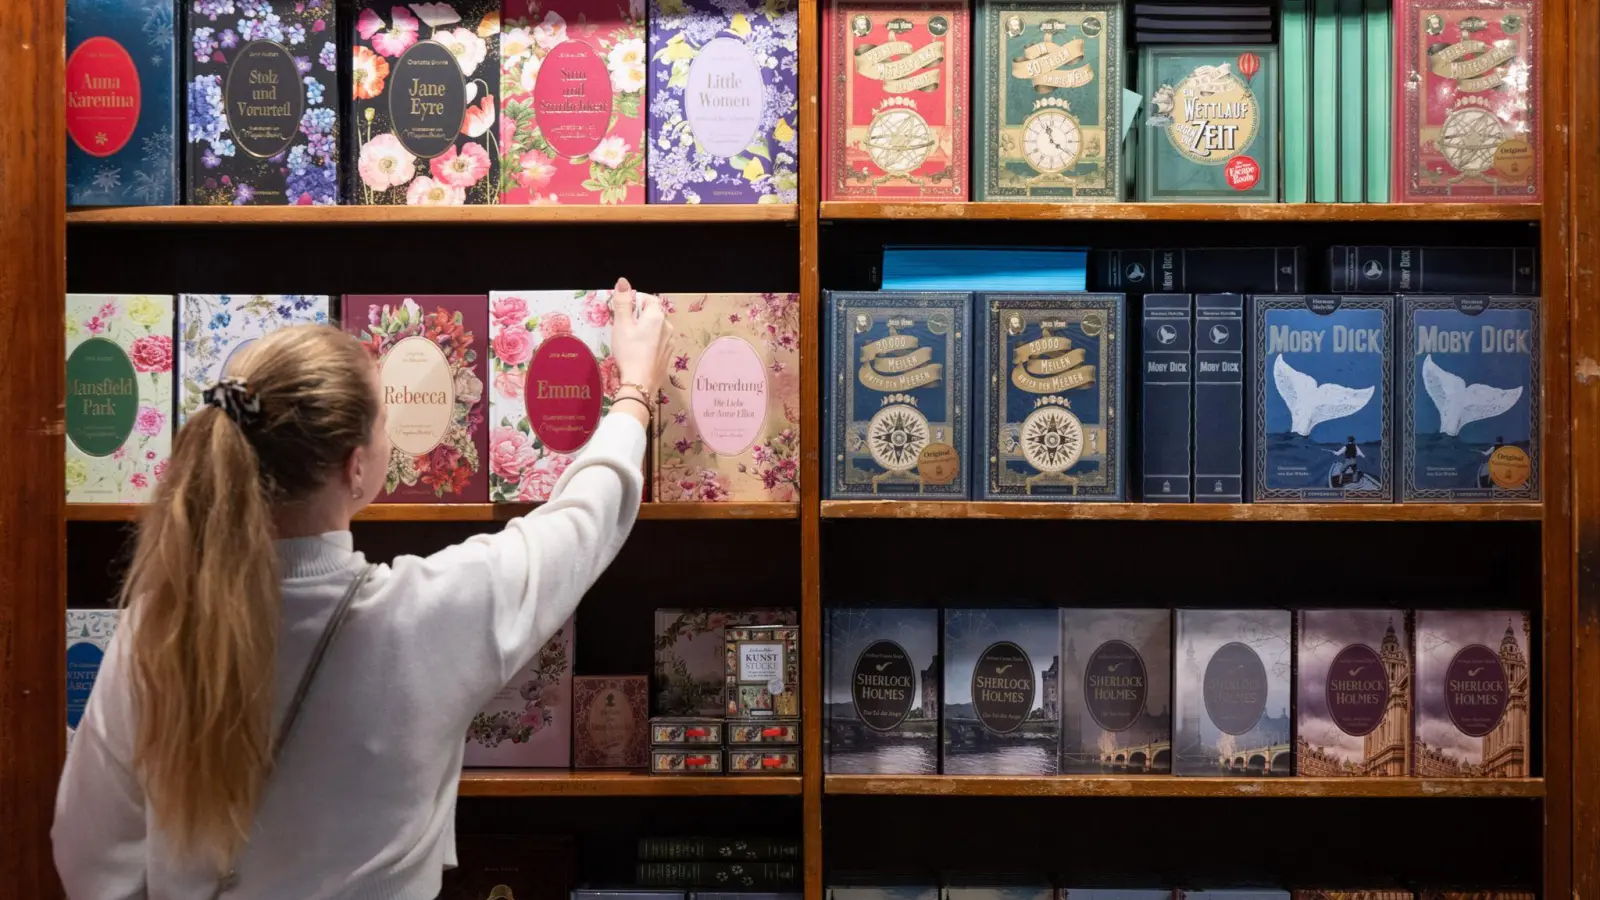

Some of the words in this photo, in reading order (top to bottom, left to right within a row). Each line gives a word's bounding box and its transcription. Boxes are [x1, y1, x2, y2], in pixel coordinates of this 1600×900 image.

[81, 73, 121, 89] Anna
[248, 69, 279, 85] Stolz
[707, 72, 743, 89] Little
[252, 86, 277, 100] und
[408, 78, 446, 96] Jane
[68, 91, 134, 108] Karenina
[699, 92, 750, 108] Women
[237, 101, 292, 116] Vorurteil
[410, 98, 444, 122] Eyre
[1184, 97, 1249, 123] WETTLAUF
[1189, 119, 1239, 157] ZEIT
[1229, 166, 1255, 178] Escape
[1400, 250, 1411, 268] DICK
[1162, 271, 1173, 291] MOBY
[1267, 324, 1326, 355] MOBY
[1333, 324, 1381, 354] DICK
[1414, 325, 1475, 355] MOBY
[1481, 325, 1530, 354] DICK
[888, 356, 918, 371] MEILEN
[1041, 356, 1072, 372] MEILEN
[1147, 361, 1168, 373] MOBY
[1169, 361, 1188, 373] DICK
[1200, 361, 1220, 373] MOBY
[1222, 361, 1239, 373] DICK
[696, 375, 764, 396] Überredung
[899, 371, 930, 388] MEEREN
[1018, 374, 1036, 388] UNTER
[1039, 381, 1050, 390] DEN
[1052, 371, 1083, 389] MEEREN
[384, 385, 447, 405] Rebecca
[536, 380, 592, 399] Emma
[82, 398, 116, 416] Park
[713, 398, 726, 407] Die
[726, 398, 744, 407] Liebe
[703, 409, 715, 418] der
[923, 449, 950, 458] Original
[1497, 452, 1525, 461] Original
[745, 653, 778, 662] KUNST
[857, 674, 911, 687] SHERLOCK
[976, 676, 1031, 690] SHERLOCK
[1089, 674, 1143, 687] SHERLOCK
[1330, 679, 1384, 692] SHERLOCK
[1449, 679, 1503, 692] SHERLOCK
[862, 686, 905, 700] HOLMES
[981, 689, 1024, 703] HOLMES
[1094, 687, 1137, 701] HOLMES
[1336, 692, 1379, 705] HOLMES
[1455, 693, 1498, 706] HOLMES
